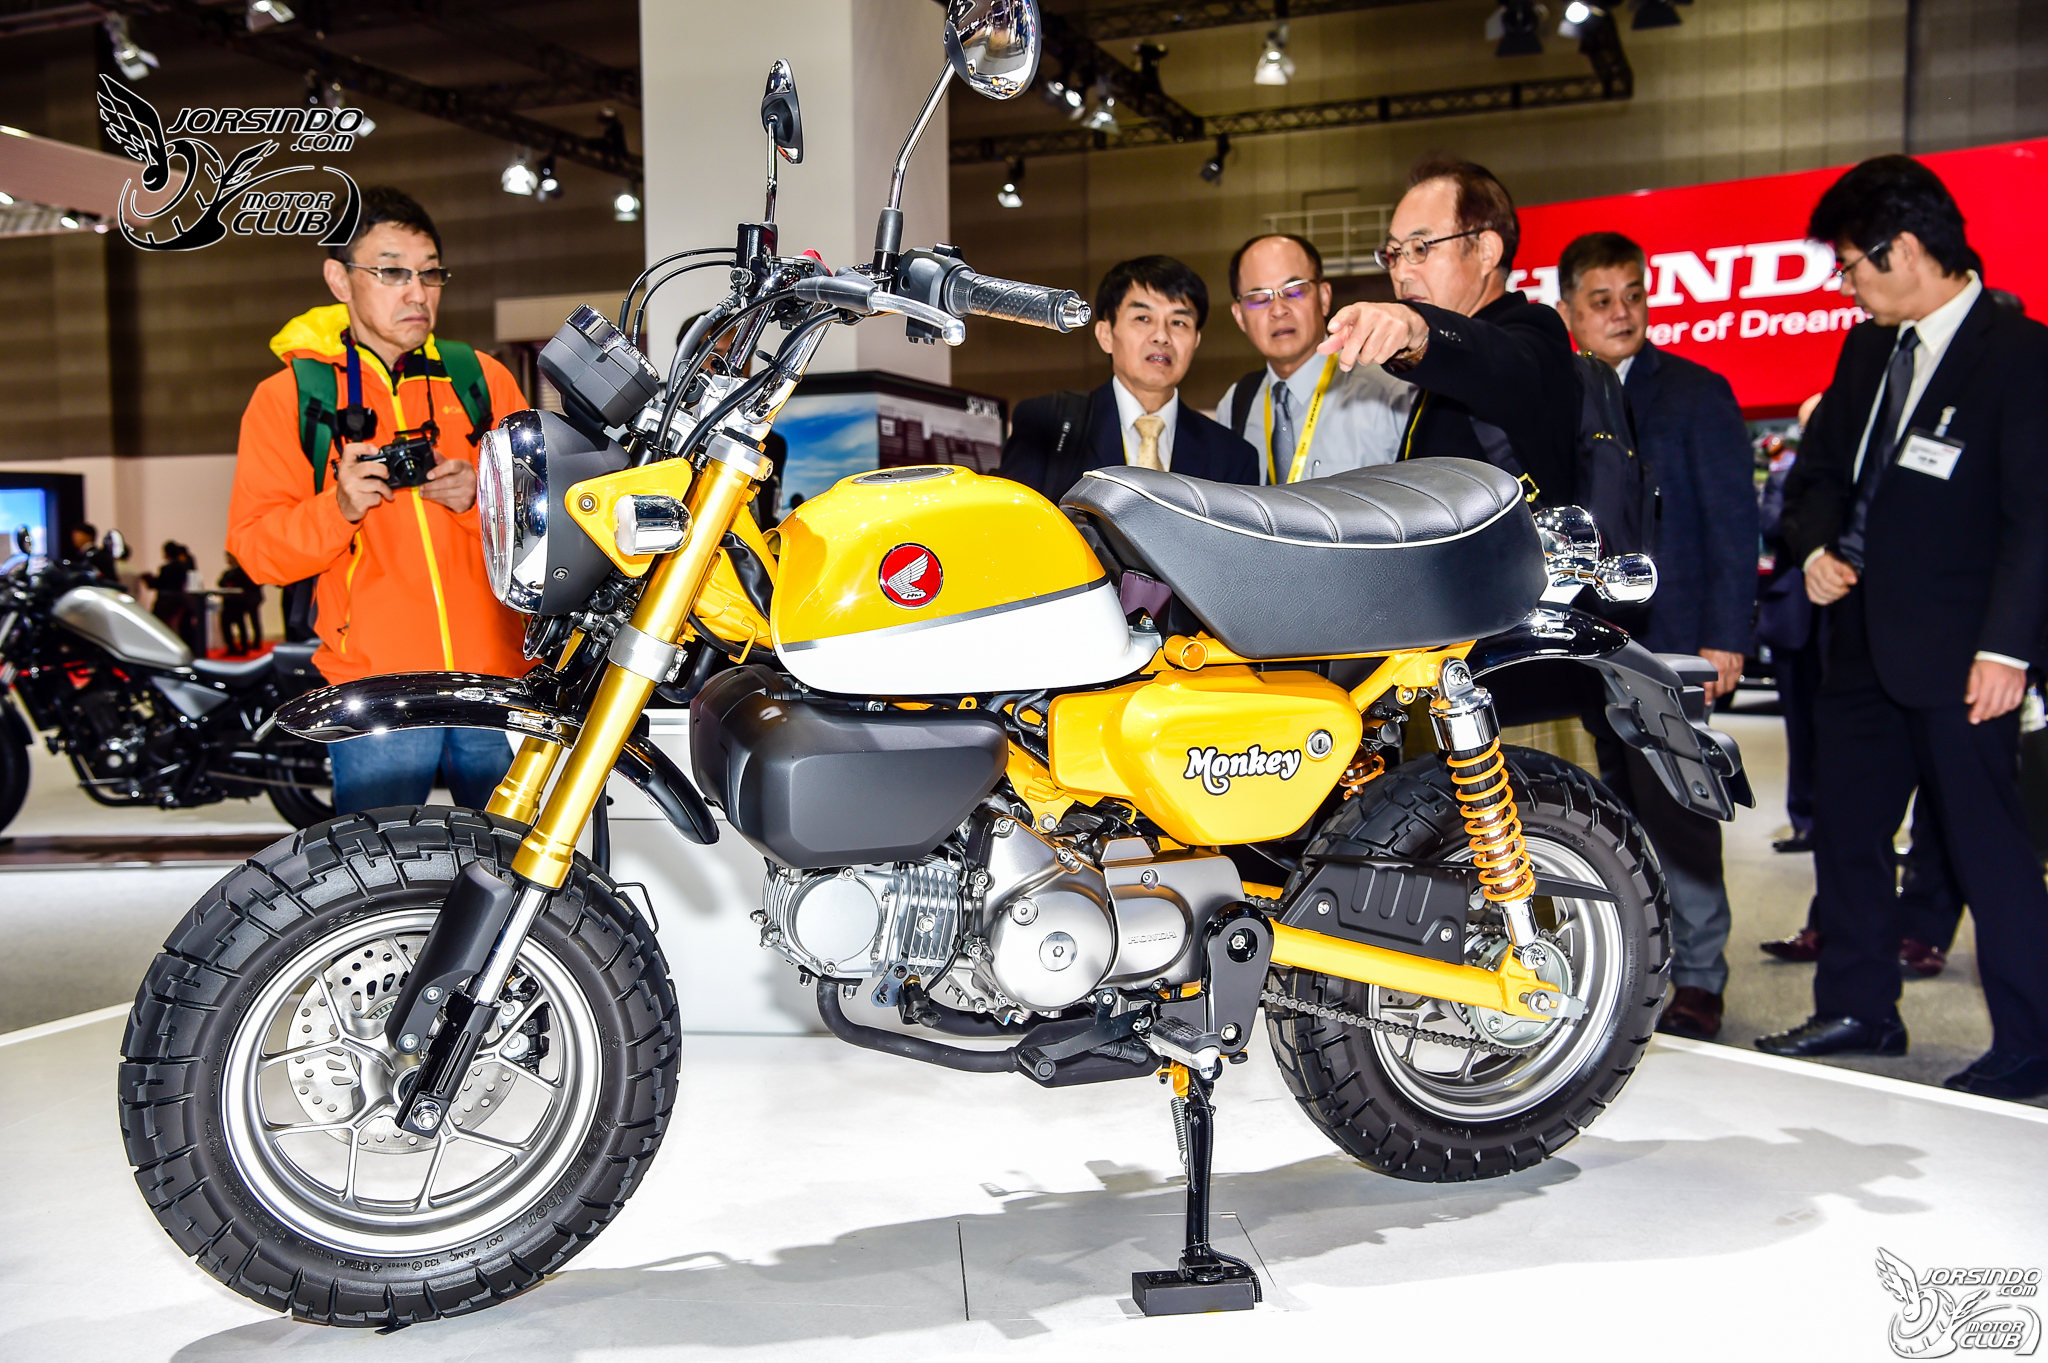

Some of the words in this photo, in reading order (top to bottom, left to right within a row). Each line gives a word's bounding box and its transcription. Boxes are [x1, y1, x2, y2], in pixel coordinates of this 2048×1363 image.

[1505, 238, 1843, 308] HND
[1691, 311, 1734, 342] of
[1740, 306, 1873, 338] Dream
[1183, 744, 1302, 796] Monkey
[1127, 931, 1178, 945] HONDA
[485, 1234, 504, 1250] DOT
